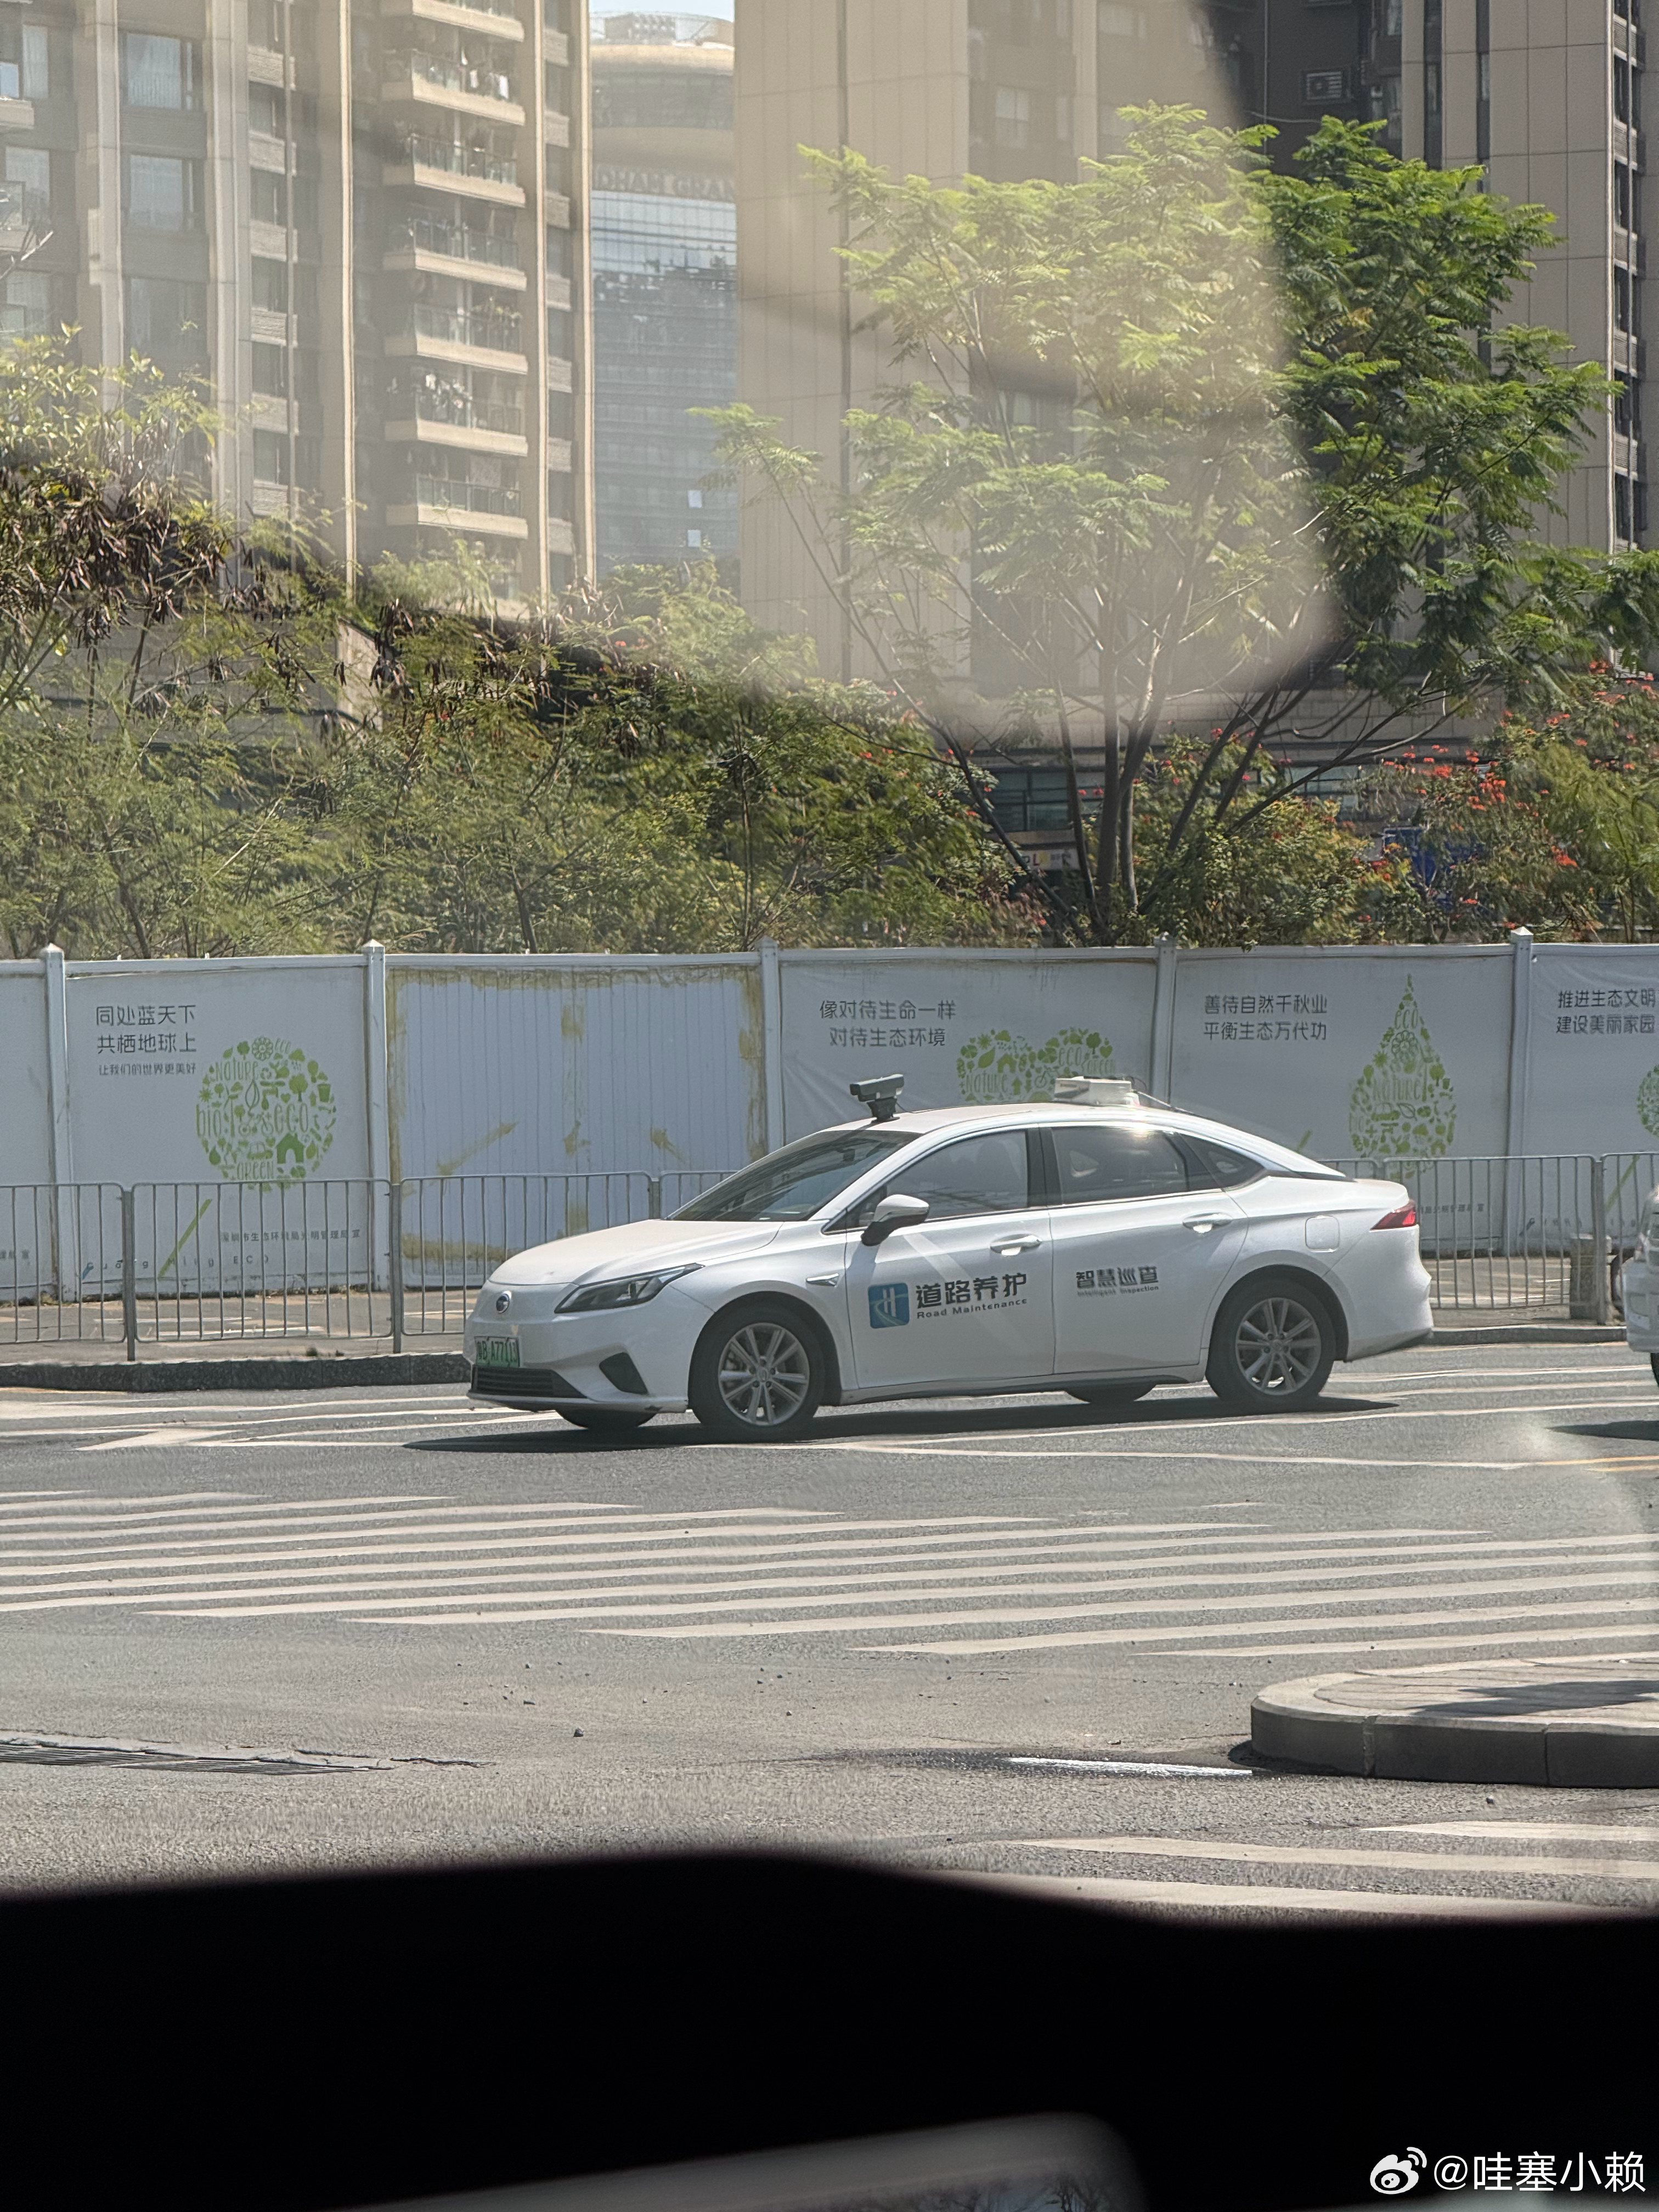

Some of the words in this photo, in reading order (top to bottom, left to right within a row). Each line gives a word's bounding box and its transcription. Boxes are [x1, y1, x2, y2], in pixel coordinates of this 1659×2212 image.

[1205, 994, 1327, 1014] 善待自然千秋业
[1558, 988, 1656, 1008] 推进生态文明
[97, 1005, 196, 1026] 同处蓝天下
[820, 1000, 956, 1019] 像对待生命一样
[1204, 1021, 1327, 1040] 平衡生态万代功
[1556, 1014, 1655, 1034] 建设美丽家园
[97, 1032, 196, 1054] 共栖地球上
[830, 1027, 946, 1047] 对待生态环境
[99, 1063, 196, 1075] 让我们的世界更美好
[1076, 1266, 1159, 1288] 智慧巡查
[916, 1272, 1026, 1309] 道路养护
[917, 1308, 947, 1319] Road
[952, 1298, 1028, 1314] Maintenance
